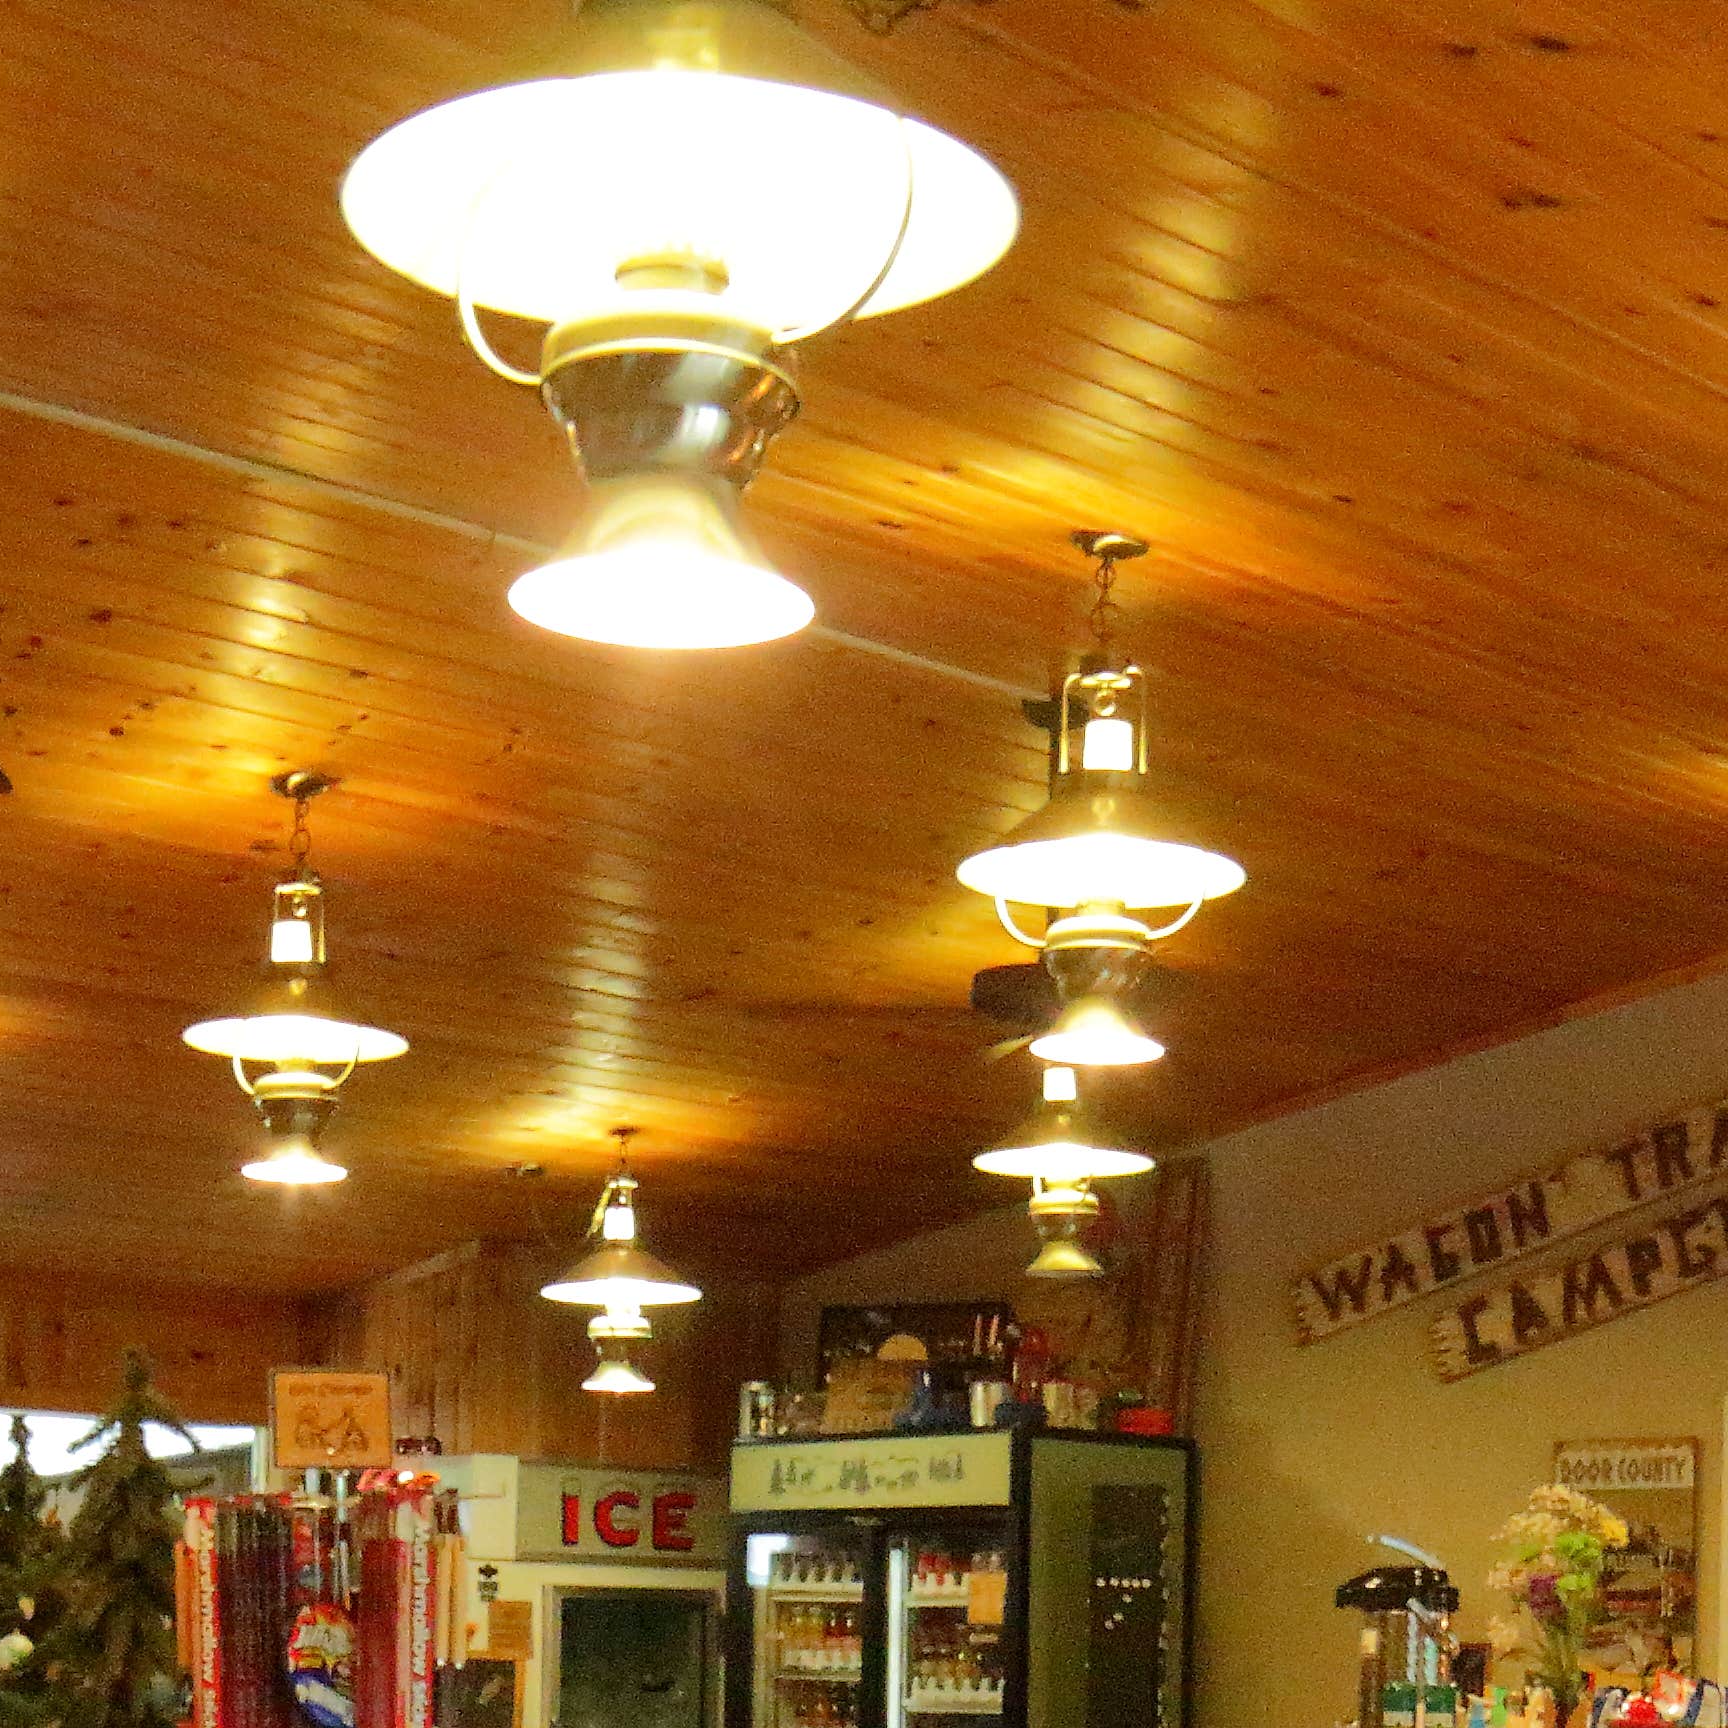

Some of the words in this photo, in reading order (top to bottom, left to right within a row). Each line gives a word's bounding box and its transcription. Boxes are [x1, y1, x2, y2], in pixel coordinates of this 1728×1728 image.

[1310, 1180, 1552, 1322] WAGON
[1559, 1456, 1613, 1484] DOOR
[1617, 1455, 1687, 1483] COUNTY
[561, 1489, 697, 1551] ICE
